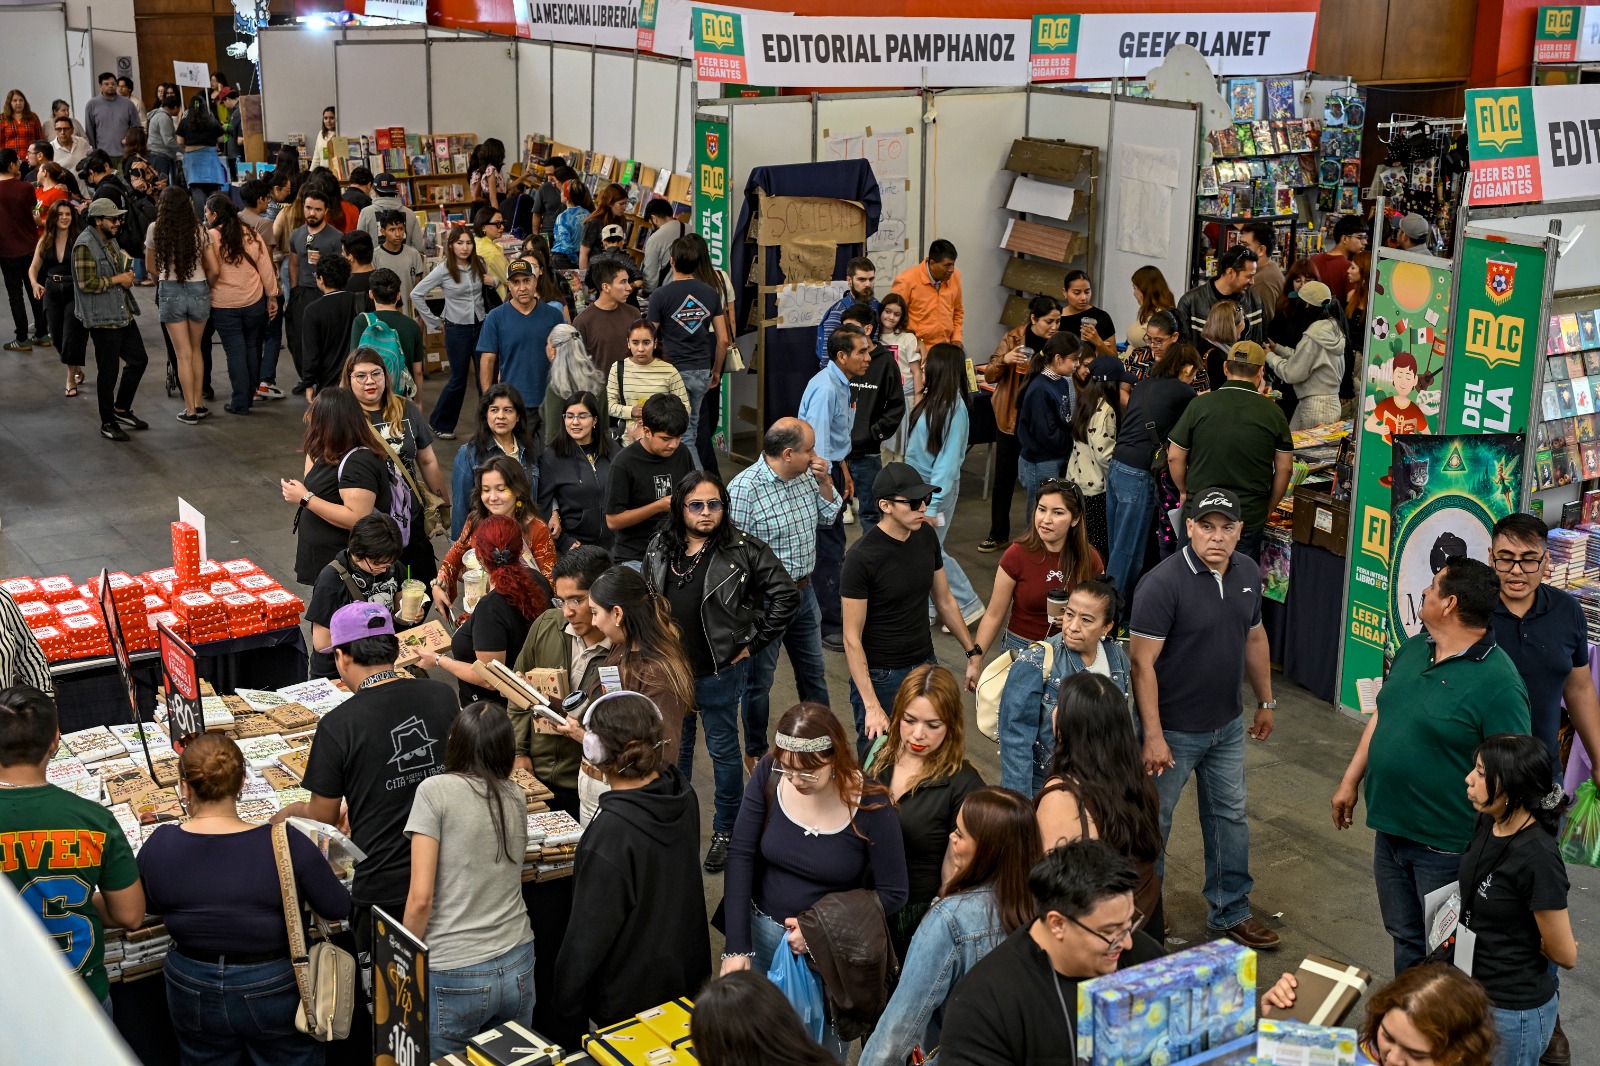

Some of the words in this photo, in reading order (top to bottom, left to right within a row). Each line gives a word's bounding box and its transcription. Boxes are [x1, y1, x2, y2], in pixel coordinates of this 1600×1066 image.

[530, 3, 543, 24] LA
[543, 3, 591, 26] MEXICANA
[593, 2, 638, 29] LIBRERÍA
[1591, 22, 1600, 44] P
[762, 33, 881, 63] EDITORIAL
[886, 33, 1015, 62] PAMPHANOZ
[1119, 31, 1181, 58] GEEK
[1185, 31, 1271, 57] PLANET
[1540, 51, 1571, 60] GIGANTES
[699, 57, 718, 67] LEER
[719, 59, 729, 68] ES
[730, 60, 741, 69] DE
[699, 67, 742, 80] GIGANTES
[1032, 58, 1050, 67] LEER
[1051, 58, 1060, 67] ES
[1061, 58, 1070, 67] DE
[1032, 67, 1070, 77] GIGANTES
[1474, 167, 1499, 183] LEER
[1502, 166, 1515, 180] ES
[1516, 165, 1532, 179] DE
[1473, 180, 1533, 199] GIGANTES
[1462, 380, 1484, 428] DEL
[1356, 573, 1375, 586] LIBRO
[1352, 606, 1379, 627] LEER
[0, 830, 106, 872] IVEN
[280, 858, 293, 890] GUESS
[286, 895, 299, 927] GUESS
[299, 973, 312, 1002] GUESS
[390, 968, 412, 1025] Vip
